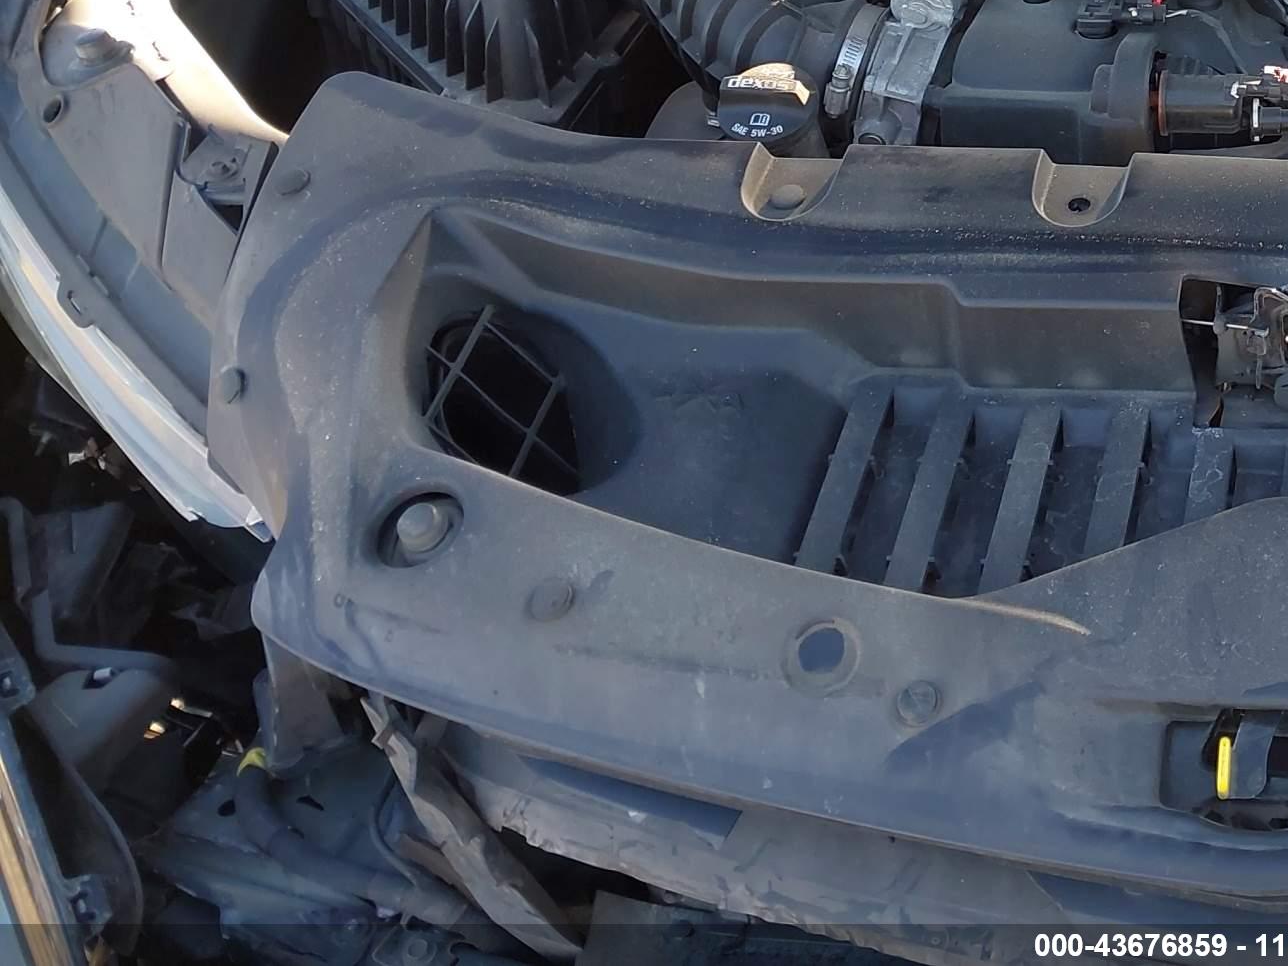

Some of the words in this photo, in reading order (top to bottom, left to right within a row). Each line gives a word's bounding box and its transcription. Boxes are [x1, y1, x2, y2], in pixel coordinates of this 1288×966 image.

[727, 76, 787, 90] dexos
[732, 123, 749, 135] SAE
[750, 125, 784, 137] 5W-30
